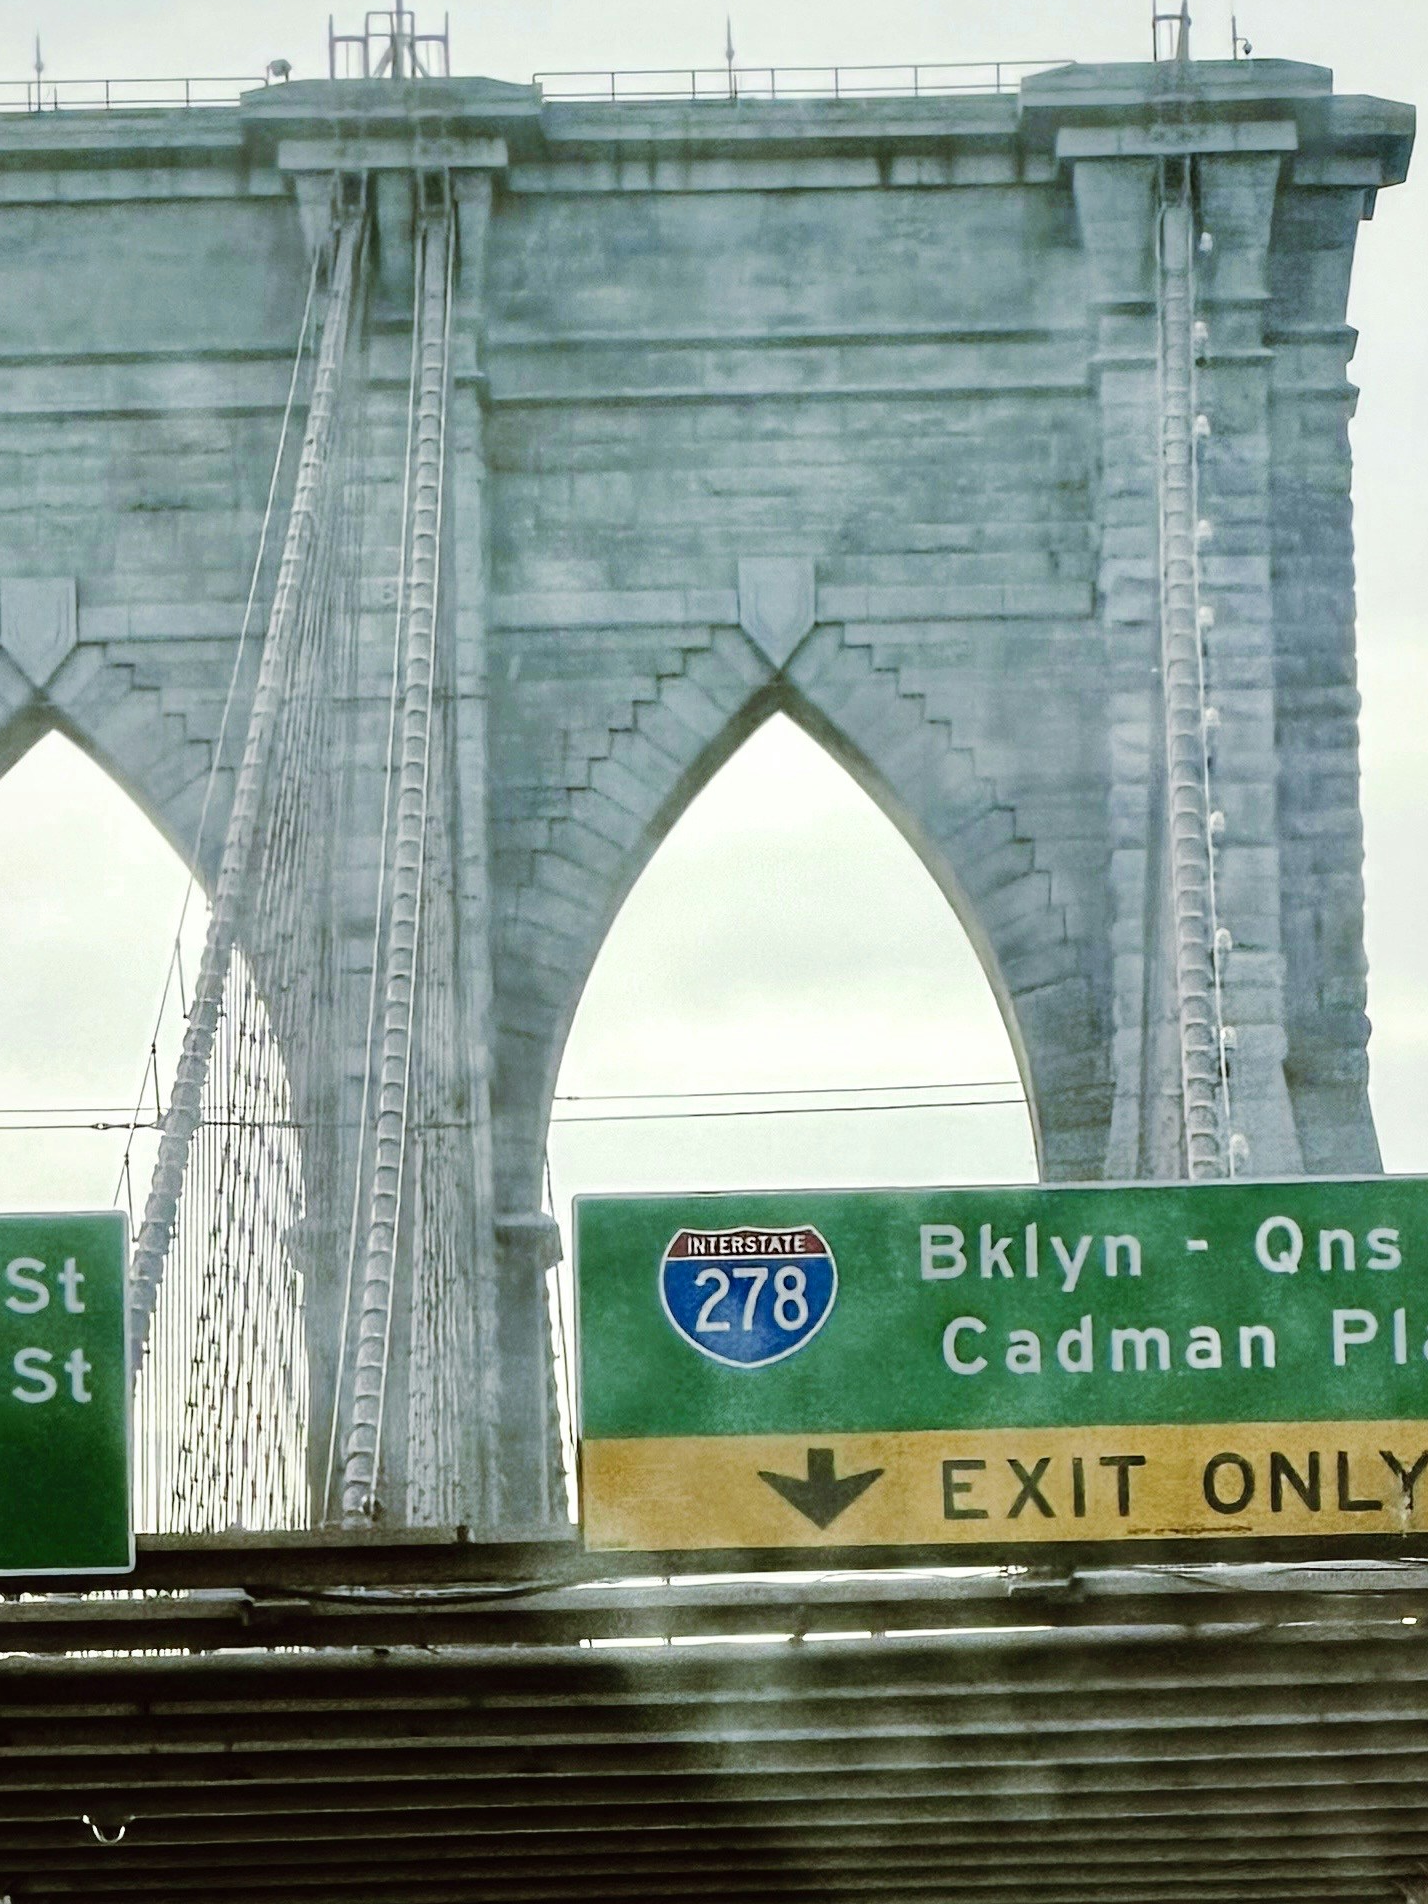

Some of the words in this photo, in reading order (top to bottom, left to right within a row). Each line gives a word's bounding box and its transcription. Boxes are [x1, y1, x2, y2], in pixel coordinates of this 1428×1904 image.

[686, 1233, 808, 1255] INTERSTATE
[920, 1221, 1142, 1293] Bklyn
[1186, 1239, 1209, 1251] -
[1255, 1215, 1402, 1275] Qns
[5, 1256, 86, 1314] St
[694, 1265, 810, 1334] 278
[12, 1346, 92, 1404] St
[942, 1314, 1276, 1375] Cadman
[942, 1454, 1148, 1521] EXIT
